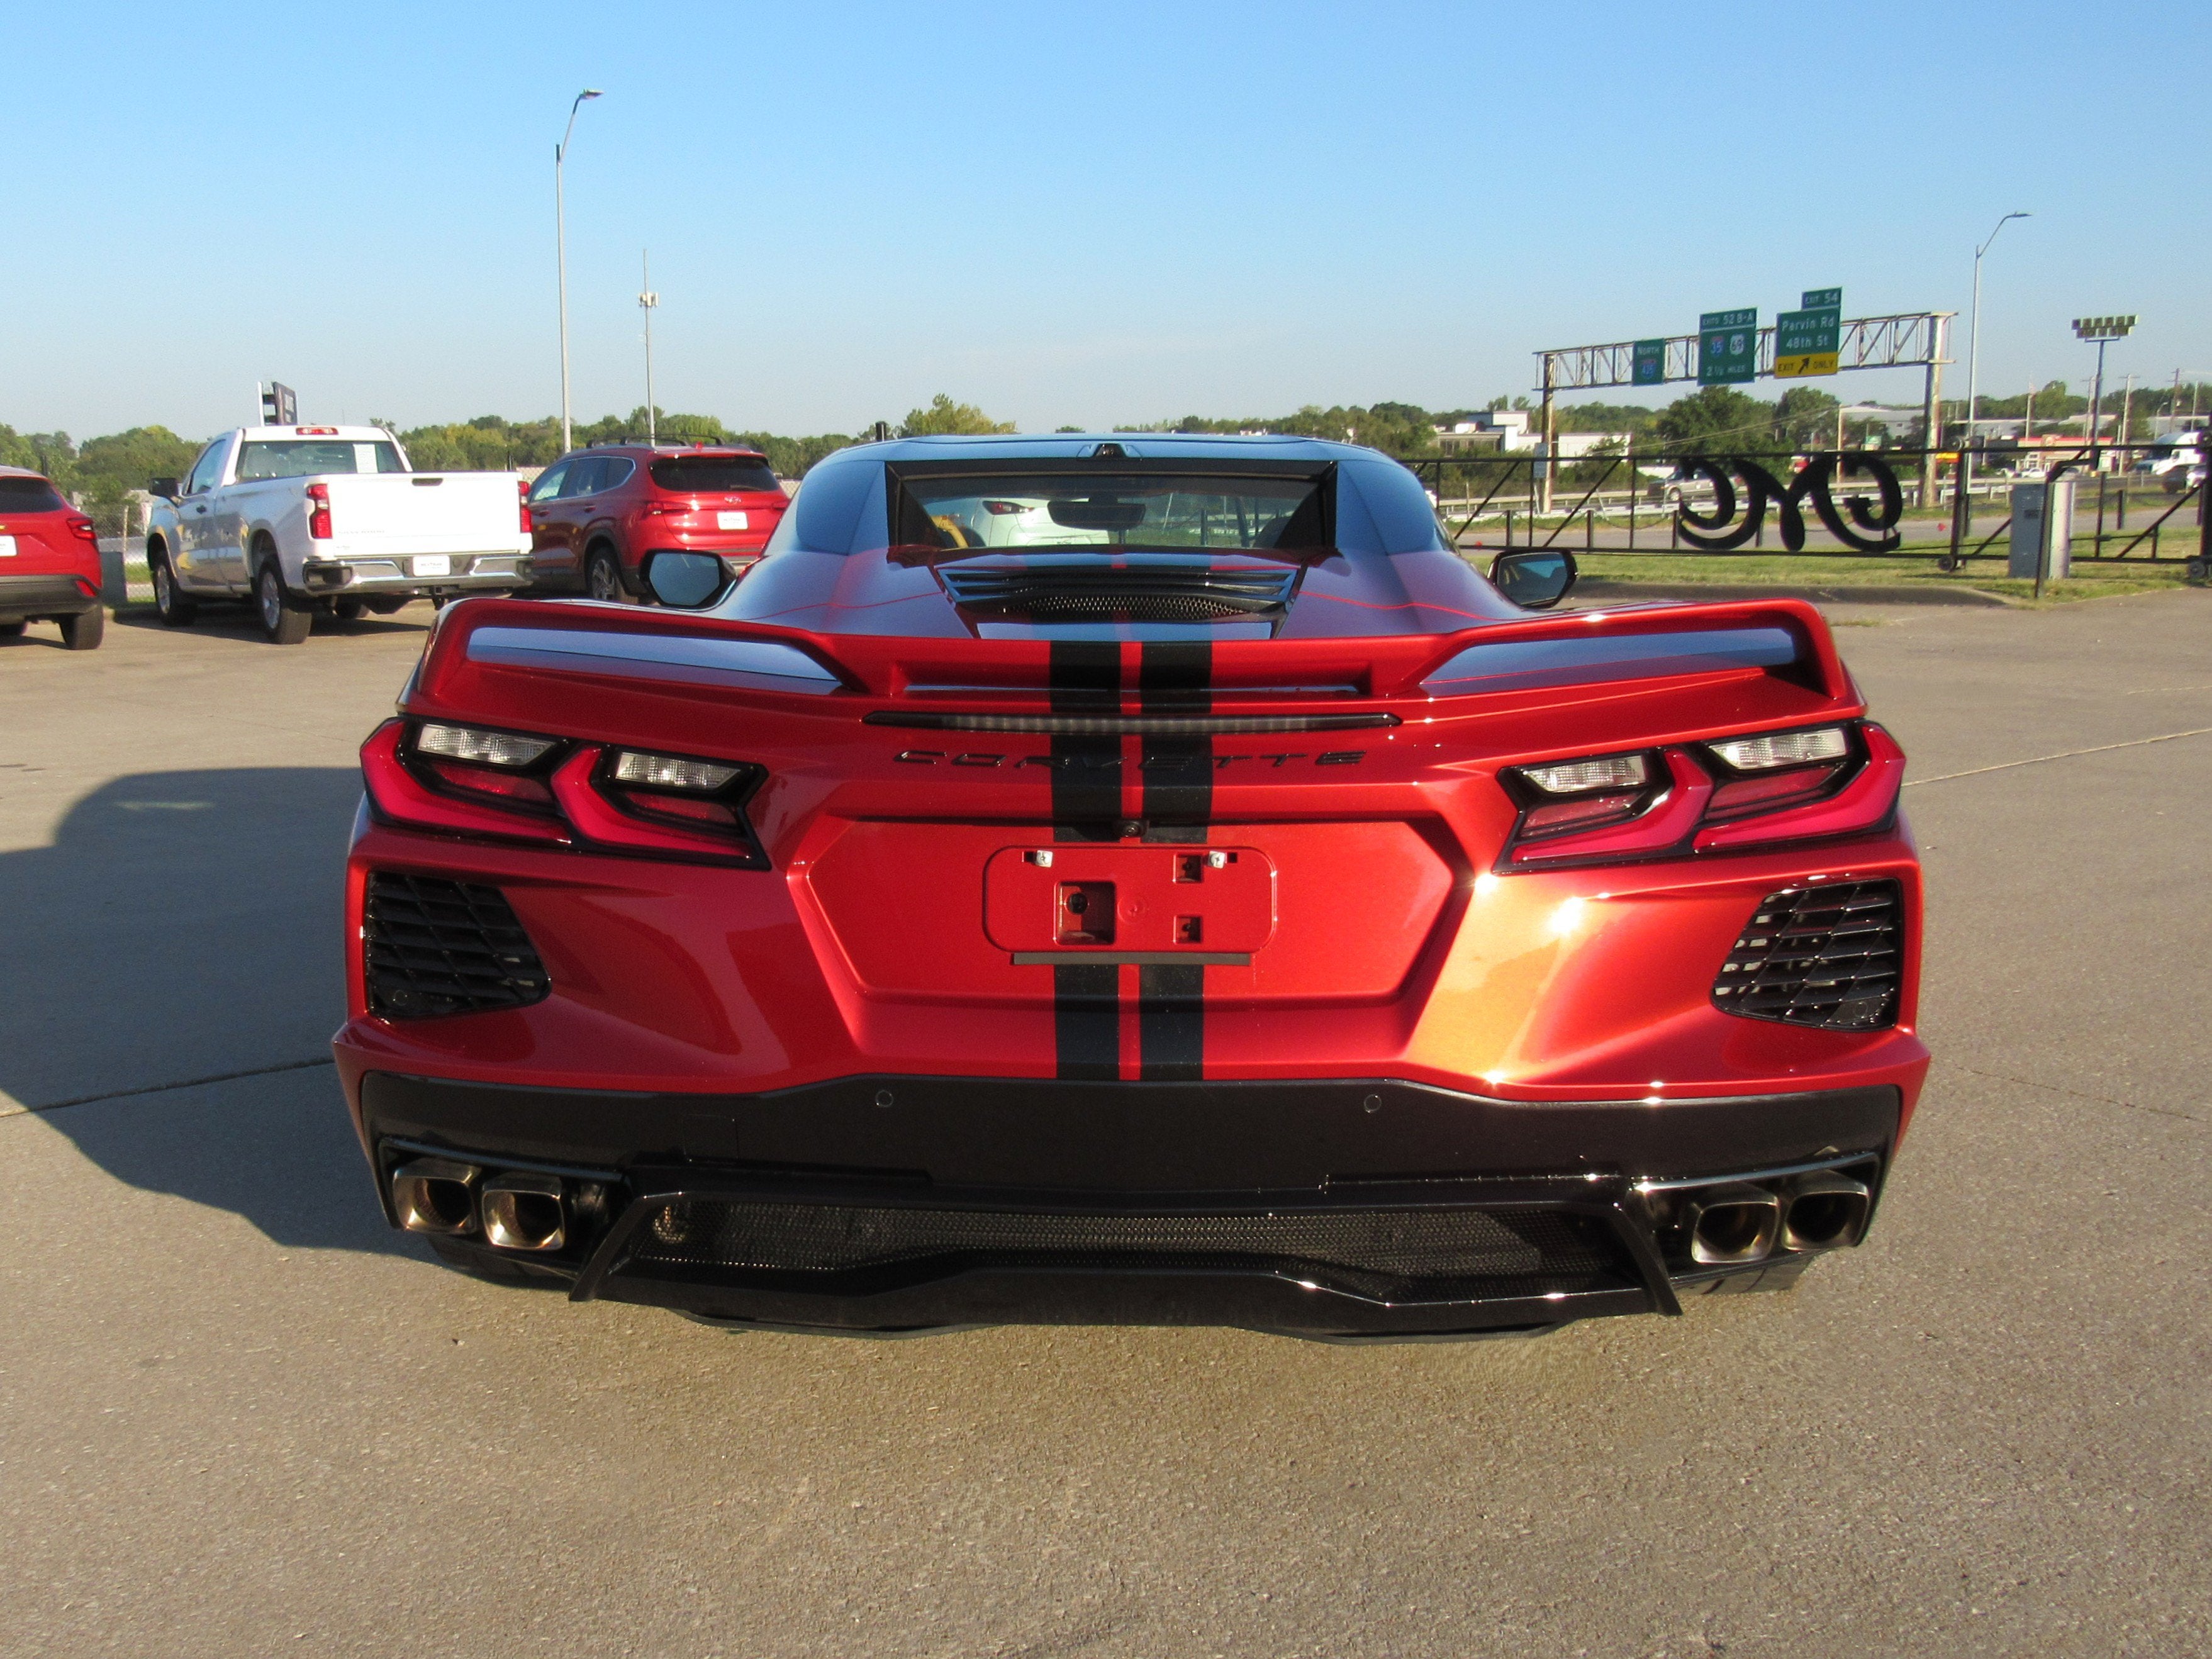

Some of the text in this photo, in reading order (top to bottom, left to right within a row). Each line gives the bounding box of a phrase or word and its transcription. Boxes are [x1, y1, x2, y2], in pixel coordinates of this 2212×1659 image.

[1824, 292, 1838, 304] 54
[1782, 316, 1835, 332] Parvin Rd
[1711, 342, 1723, 354] 35
[1787, 335, 1828, 349] 48th St
[1637, 346, 1660, 355] NORTH
[1778, 359, 1834, 372] EXIT ONLY
[892, 748, 1367, 771] CORVETTE
